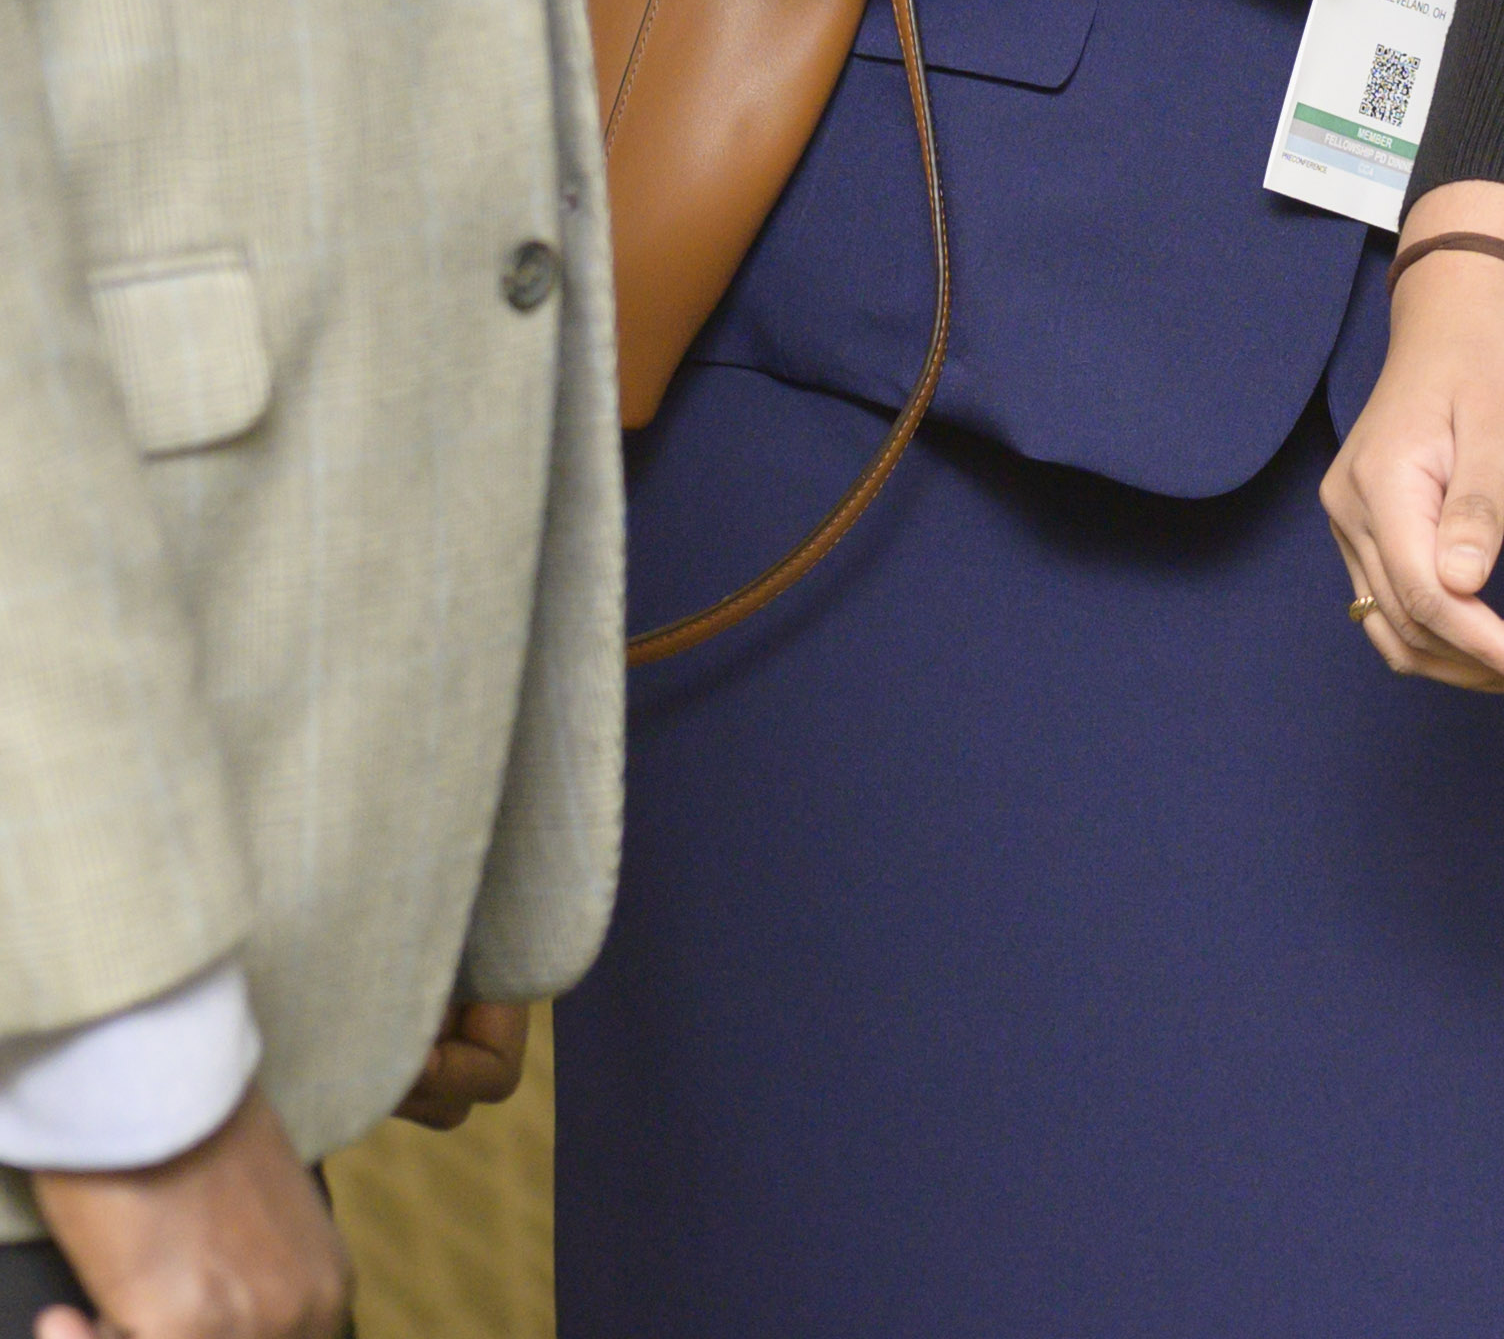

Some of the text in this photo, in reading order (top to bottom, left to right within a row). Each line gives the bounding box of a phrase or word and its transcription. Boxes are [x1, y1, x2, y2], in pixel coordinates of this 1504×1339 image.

[1432, 3, 1447, 21] OH
[1324, 132, 1375, 158] FELLOWSHIP
[1374, 151, 1388, 164] PD
[1356, 127, 1394, 149] MEMBER
[1281, 151, 1328, 174] PRECONFERENCE
